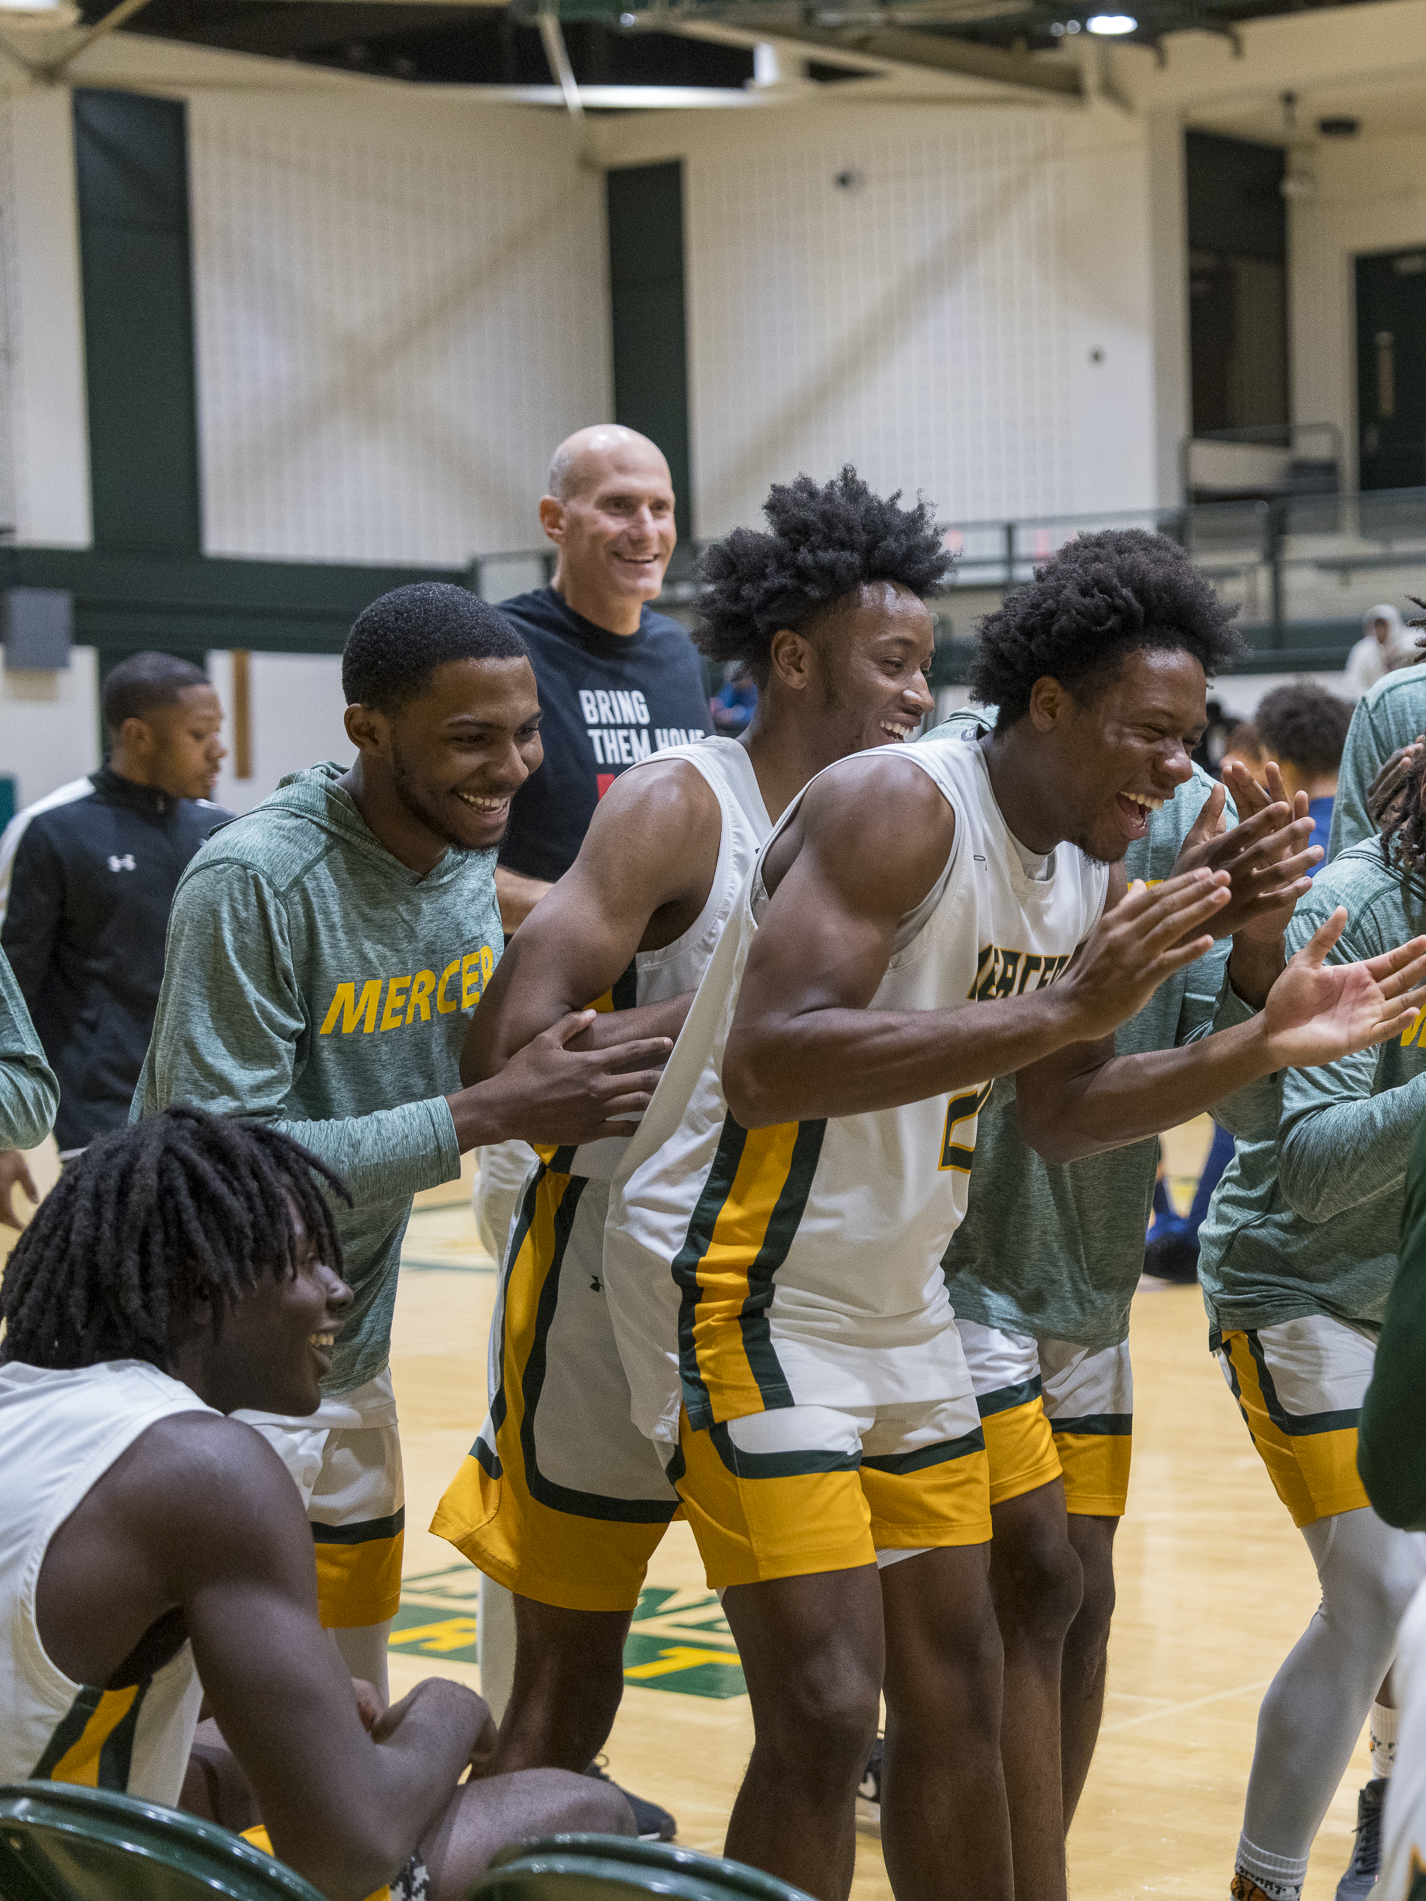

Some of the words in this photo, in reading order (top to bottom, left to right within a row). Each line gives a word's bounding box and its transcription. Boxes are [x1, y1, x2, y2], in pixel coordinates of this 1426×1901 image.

[578, 689, 651, 725] BRING
[586, 728, 652, 765] THEM
[319, 945, 494, 1034] MERCER
